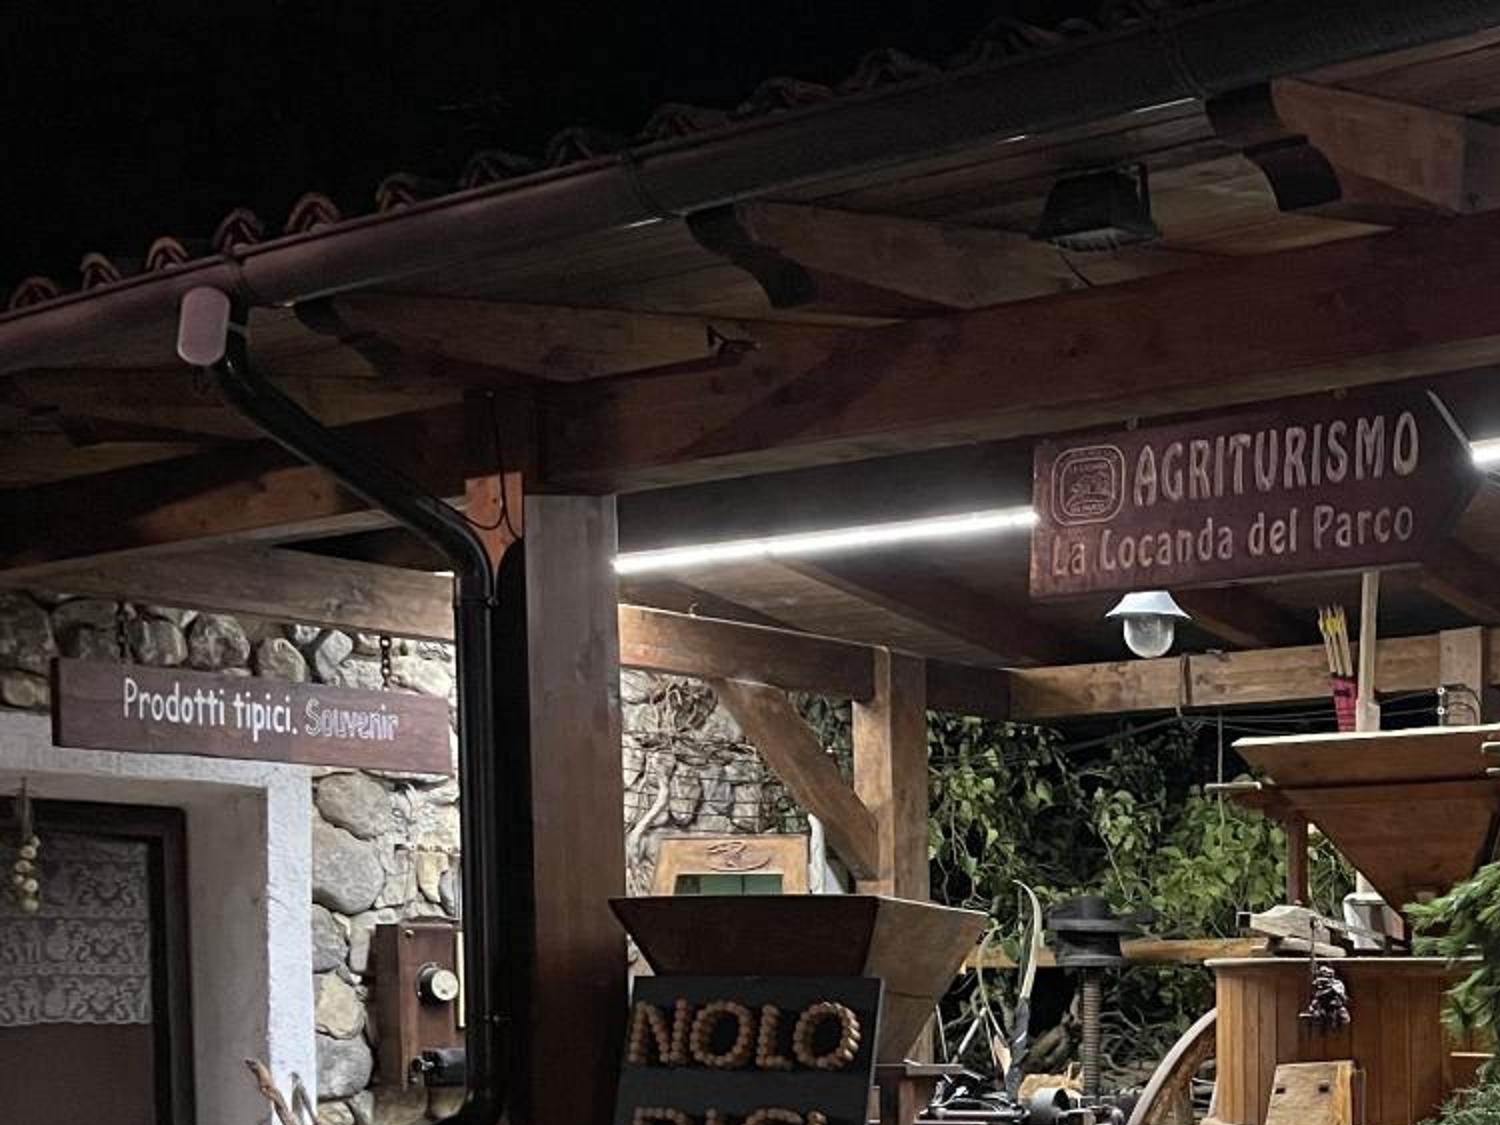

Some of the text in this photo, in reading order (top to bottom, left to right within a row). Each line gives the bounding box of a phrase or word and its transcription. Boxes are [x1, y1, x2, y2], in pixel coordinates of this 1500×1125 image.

[1133, 410, 1420, 506] AGRITURISMO
[1052, 504, 1414, 577] La Locanda del Parco
[122, 677, 401, 742] Prodotti tipici. Souvenir
[626, 997, 864, 1073] NOLO
